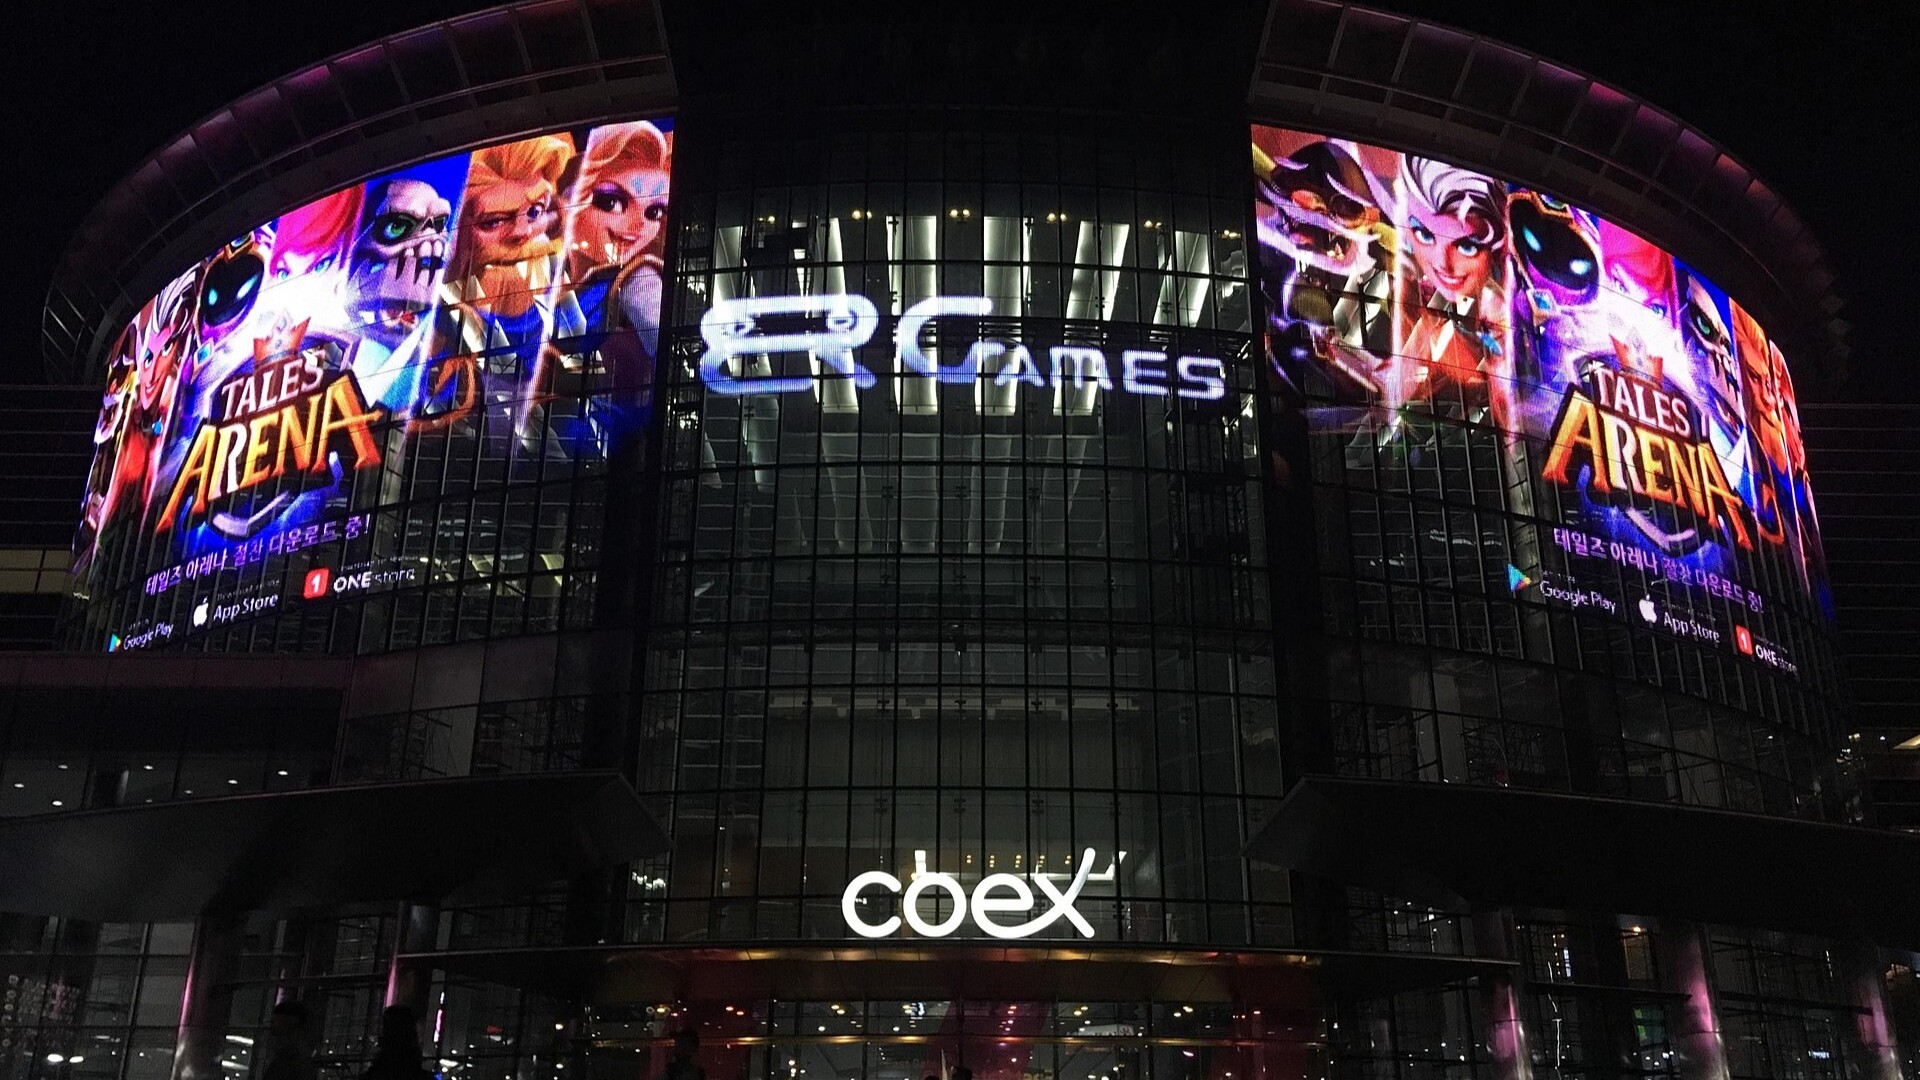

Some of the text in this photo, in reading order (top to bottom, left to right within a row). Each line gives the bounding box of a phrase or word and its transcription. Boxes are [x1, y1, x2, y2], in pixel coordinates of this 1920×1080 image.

[221, 356, 326, 423] TALES
[1593, 366, 1691, 438] TALES
[156, 374, 384, 533] ARENA
[1542, 390, 1754, 551] ARENA
[145, 568, 182, 597] 테일즈
[186, 547, 228, 580] 아레나
[269, 520, 341, 555] 다운로드
[333, 571, 373, 593] ONE
[1553, 527, 1608, 560] 테일즈
[1610, 542, 1659, 576] 아레나
[1695, 568, 1746, 606] 다운로드
[213, 593, 280, 623] App Store
[1540, 580, 1617, 616] Google Play
[1663, 611, 1721, 645] App Store
[123, 628, 155, 651] Google
[155, 621, 175, 639] Play
[1755, 643, 1778, 667] ONE
[841, 847, 1095, 938] coex
